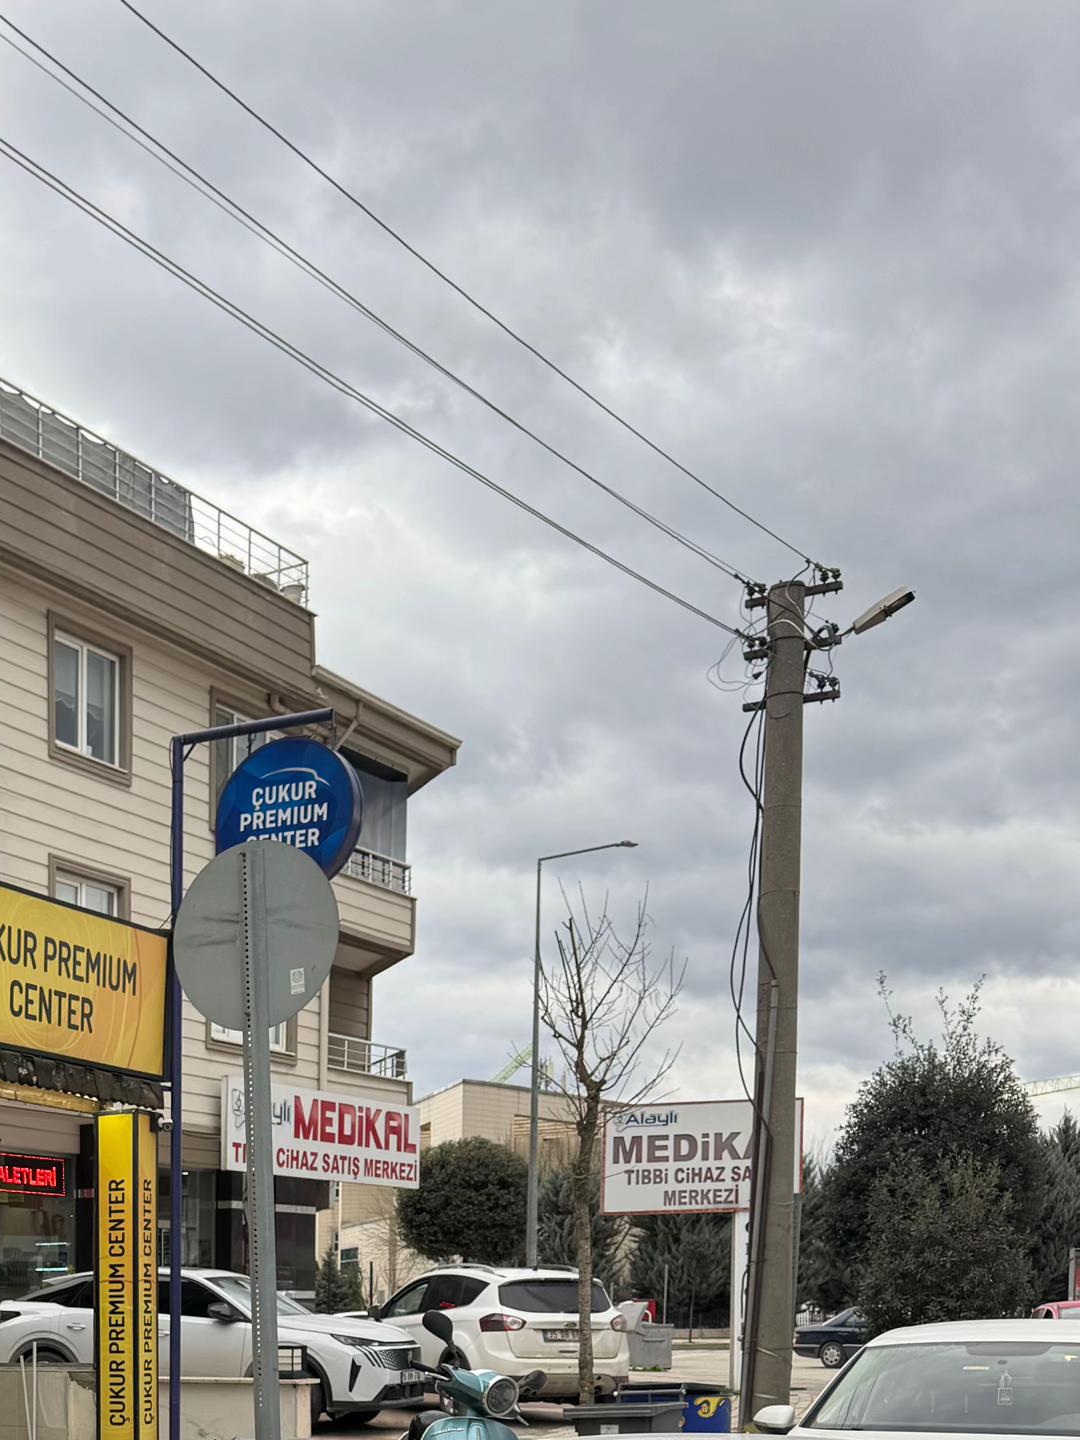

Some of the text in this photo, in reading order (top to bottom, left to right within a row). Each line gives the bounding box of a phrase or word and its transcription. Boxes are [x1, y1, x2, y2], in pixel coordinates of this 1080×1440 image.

[252, 780, 318, 811] ÇUKUR
[240, 802, 329, 833] PREMIUM
[43, 936, 138, 997] PREMIUM
[9, 979, 95, 1034] CENTER
[322, 1153, 360, 1180] SATIŞ
[364, 1158, 418, 1182] MERKEZİ
[663, 1184, 739, 1207] MERKEZİ
[108, 1179, 131, 1427] ÇUKUR PREMIUM CENTER
[143, 1179, 156, 1425] ÇUKUR PREMIUM CENTER
